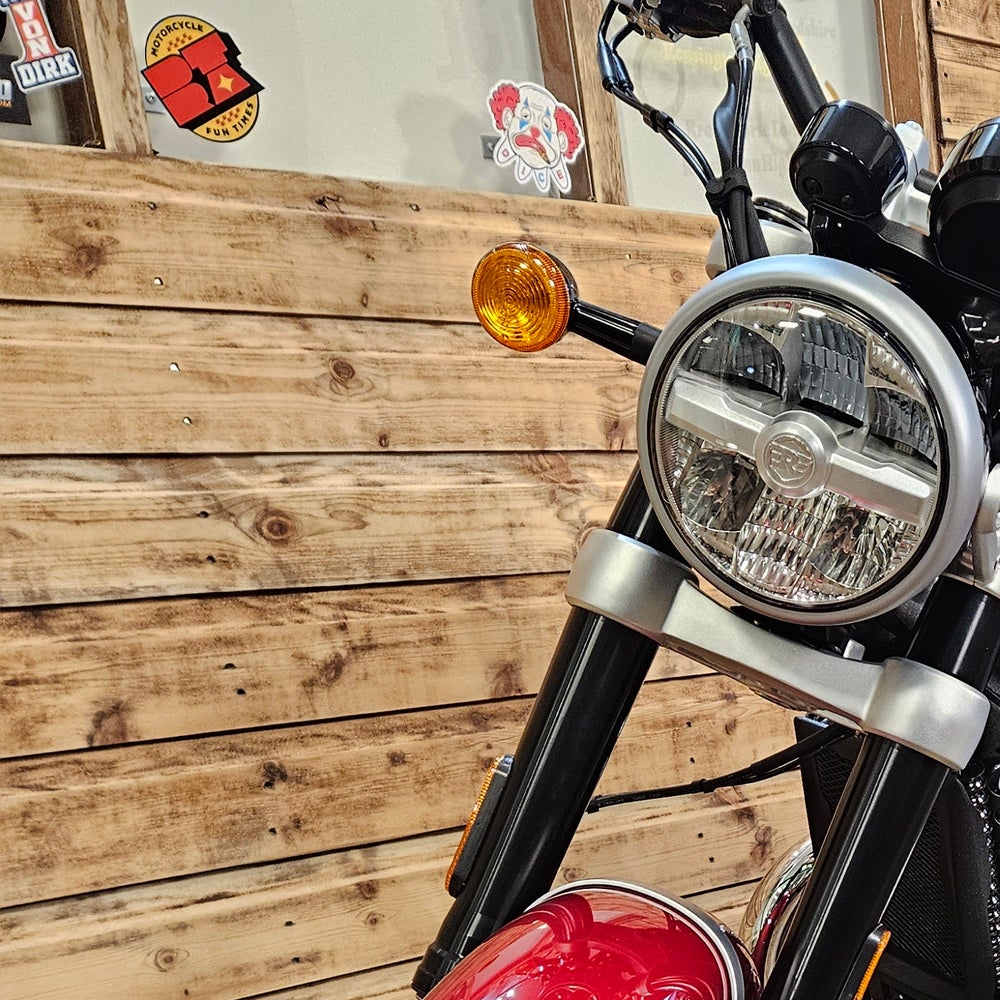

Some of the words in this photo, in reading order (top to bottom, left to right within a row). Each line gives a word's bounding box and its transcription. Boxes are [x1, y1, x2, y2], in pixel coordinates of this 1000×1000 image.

[11, 2, 52, 59] VON
[151, 21, 203, 57] MOTORCYCLE
[17, 51, 77, 87] DIRK
[206, 127, 230, 136] FUN
[212, 102, 254, 132] TIMES
